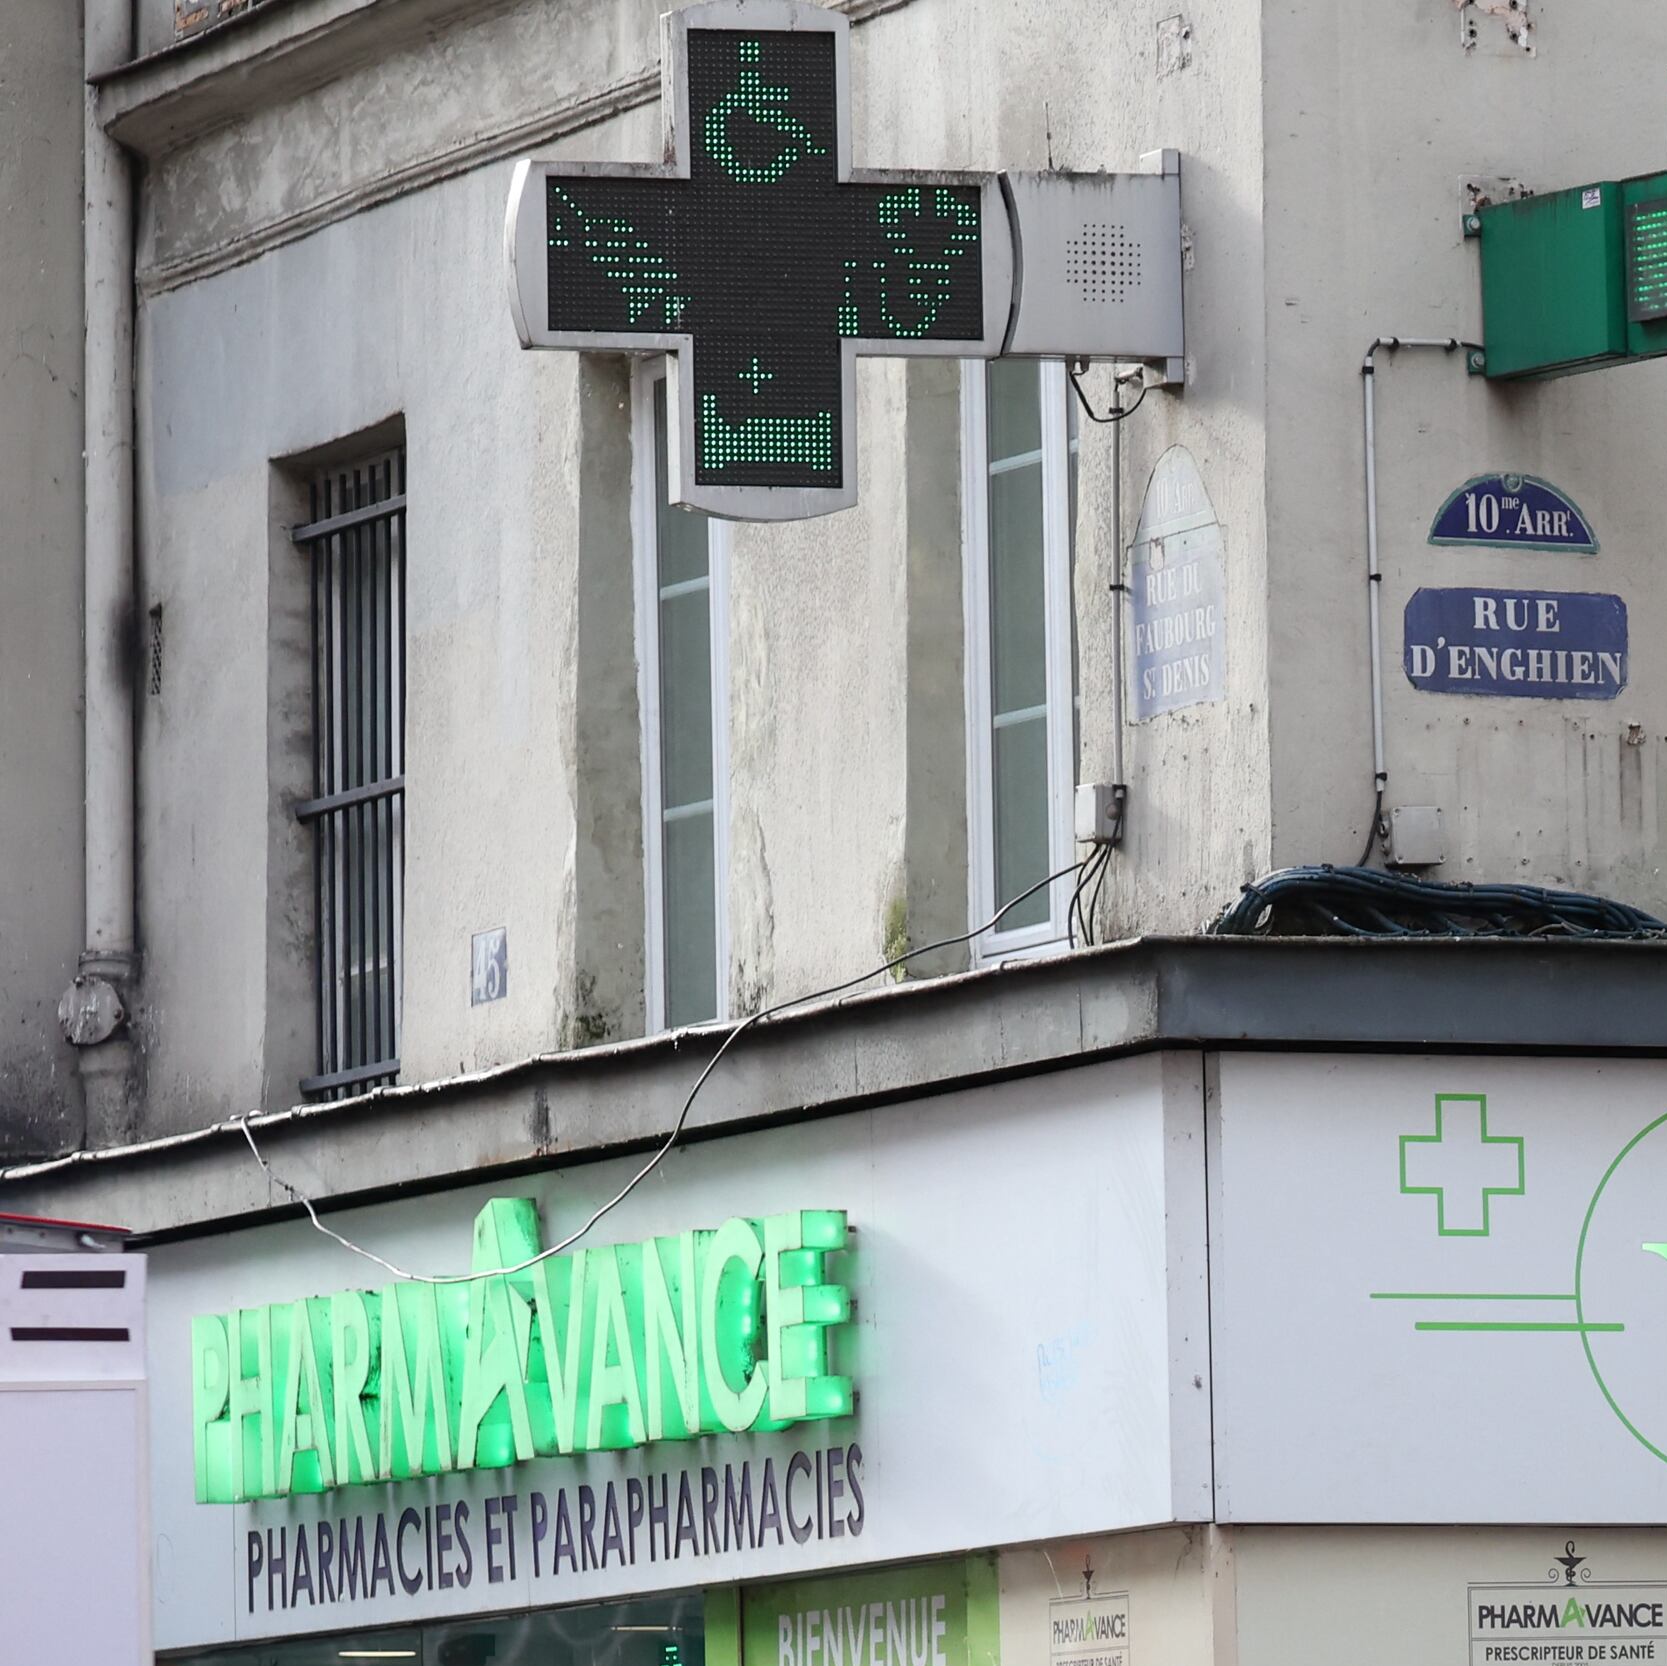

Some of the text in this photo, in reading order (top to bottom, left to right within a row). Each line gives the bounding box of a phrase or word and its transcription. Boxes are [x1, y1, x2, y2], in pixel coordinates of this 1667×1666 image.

[1145, 561, 1203, 608] RUE DU
[1135, 605, 1217, 656] FAUBOURG
[1472, 596, 1561, 632] RUE
[1161, 654, 1210, 698] DENIS
[1410, 636, 1622, 685] D'ENGHIEN
[191, 1197, 854, 1504] PHARMAVANCE
[247, 1442, 866, 1614] PHARMACIES ET PARAPHARMACIES
[1053, 1608, 1126, 1646] PHARMAVANCE
[1478, 1597, 1664, 1629] PHARMAVANCE
[1485, 1641, 1655, 1662] PRESCRIPTEUR DE SANTÉ
